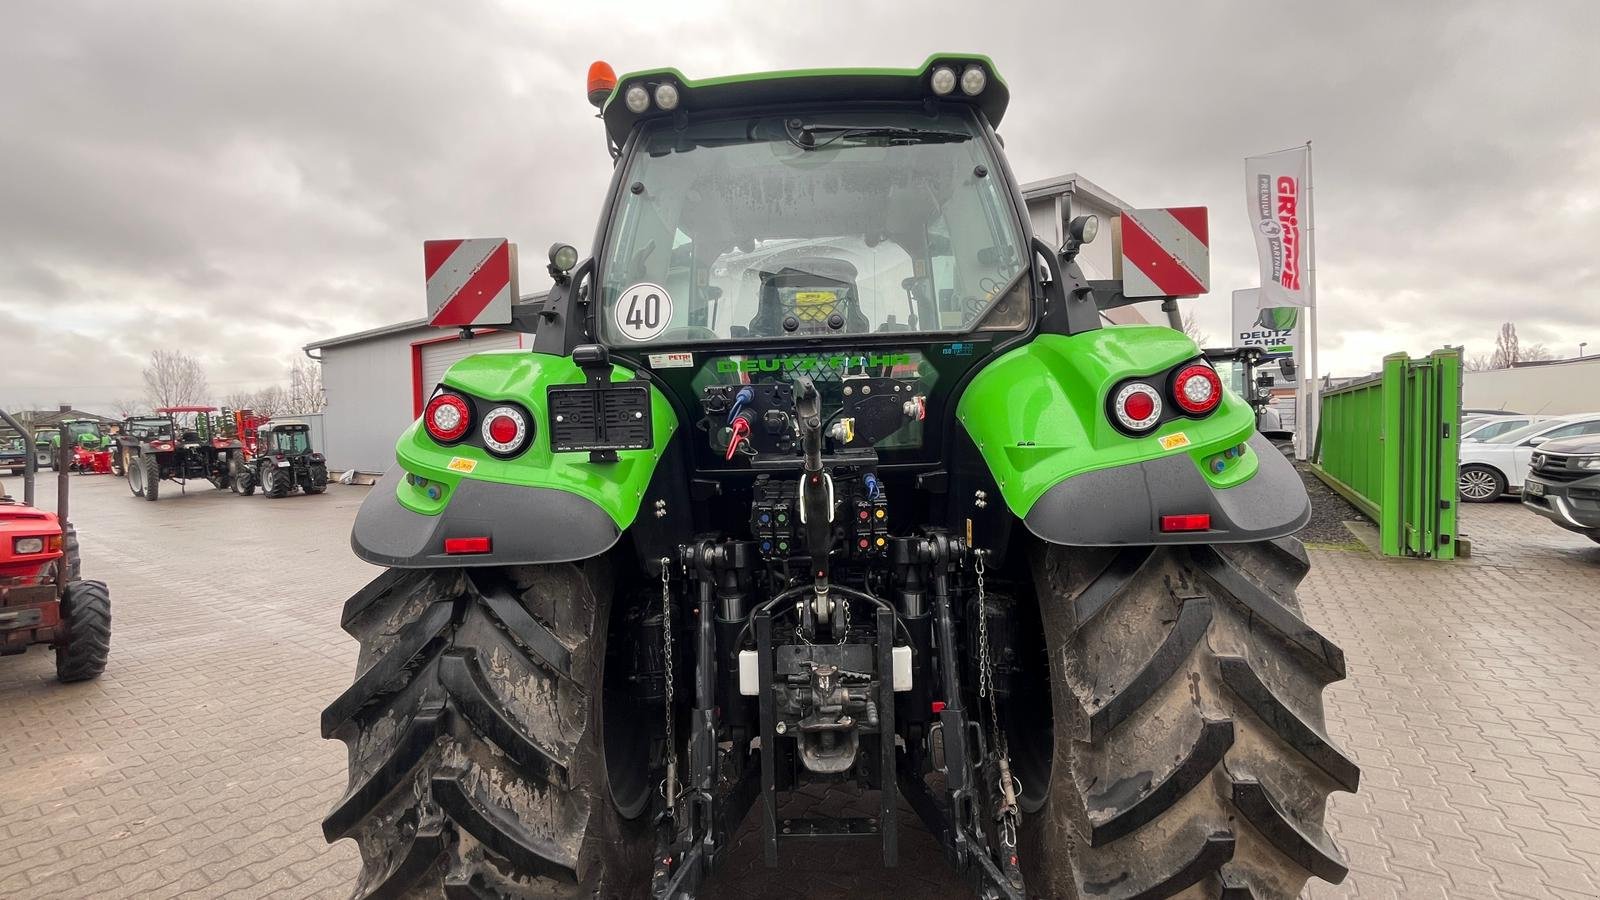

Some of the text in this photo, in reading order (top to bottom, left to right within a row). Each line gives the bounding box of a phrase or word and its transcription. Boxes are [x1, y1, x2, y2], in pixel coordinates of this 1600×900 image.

[1260, 177, 1280, 277] PREMIUM PARTNER
[626, 294, 660, 329] 40
[1240, 329, 1292, 340] DEUTZ
[1244, 338, 1286, 346] FAHR
